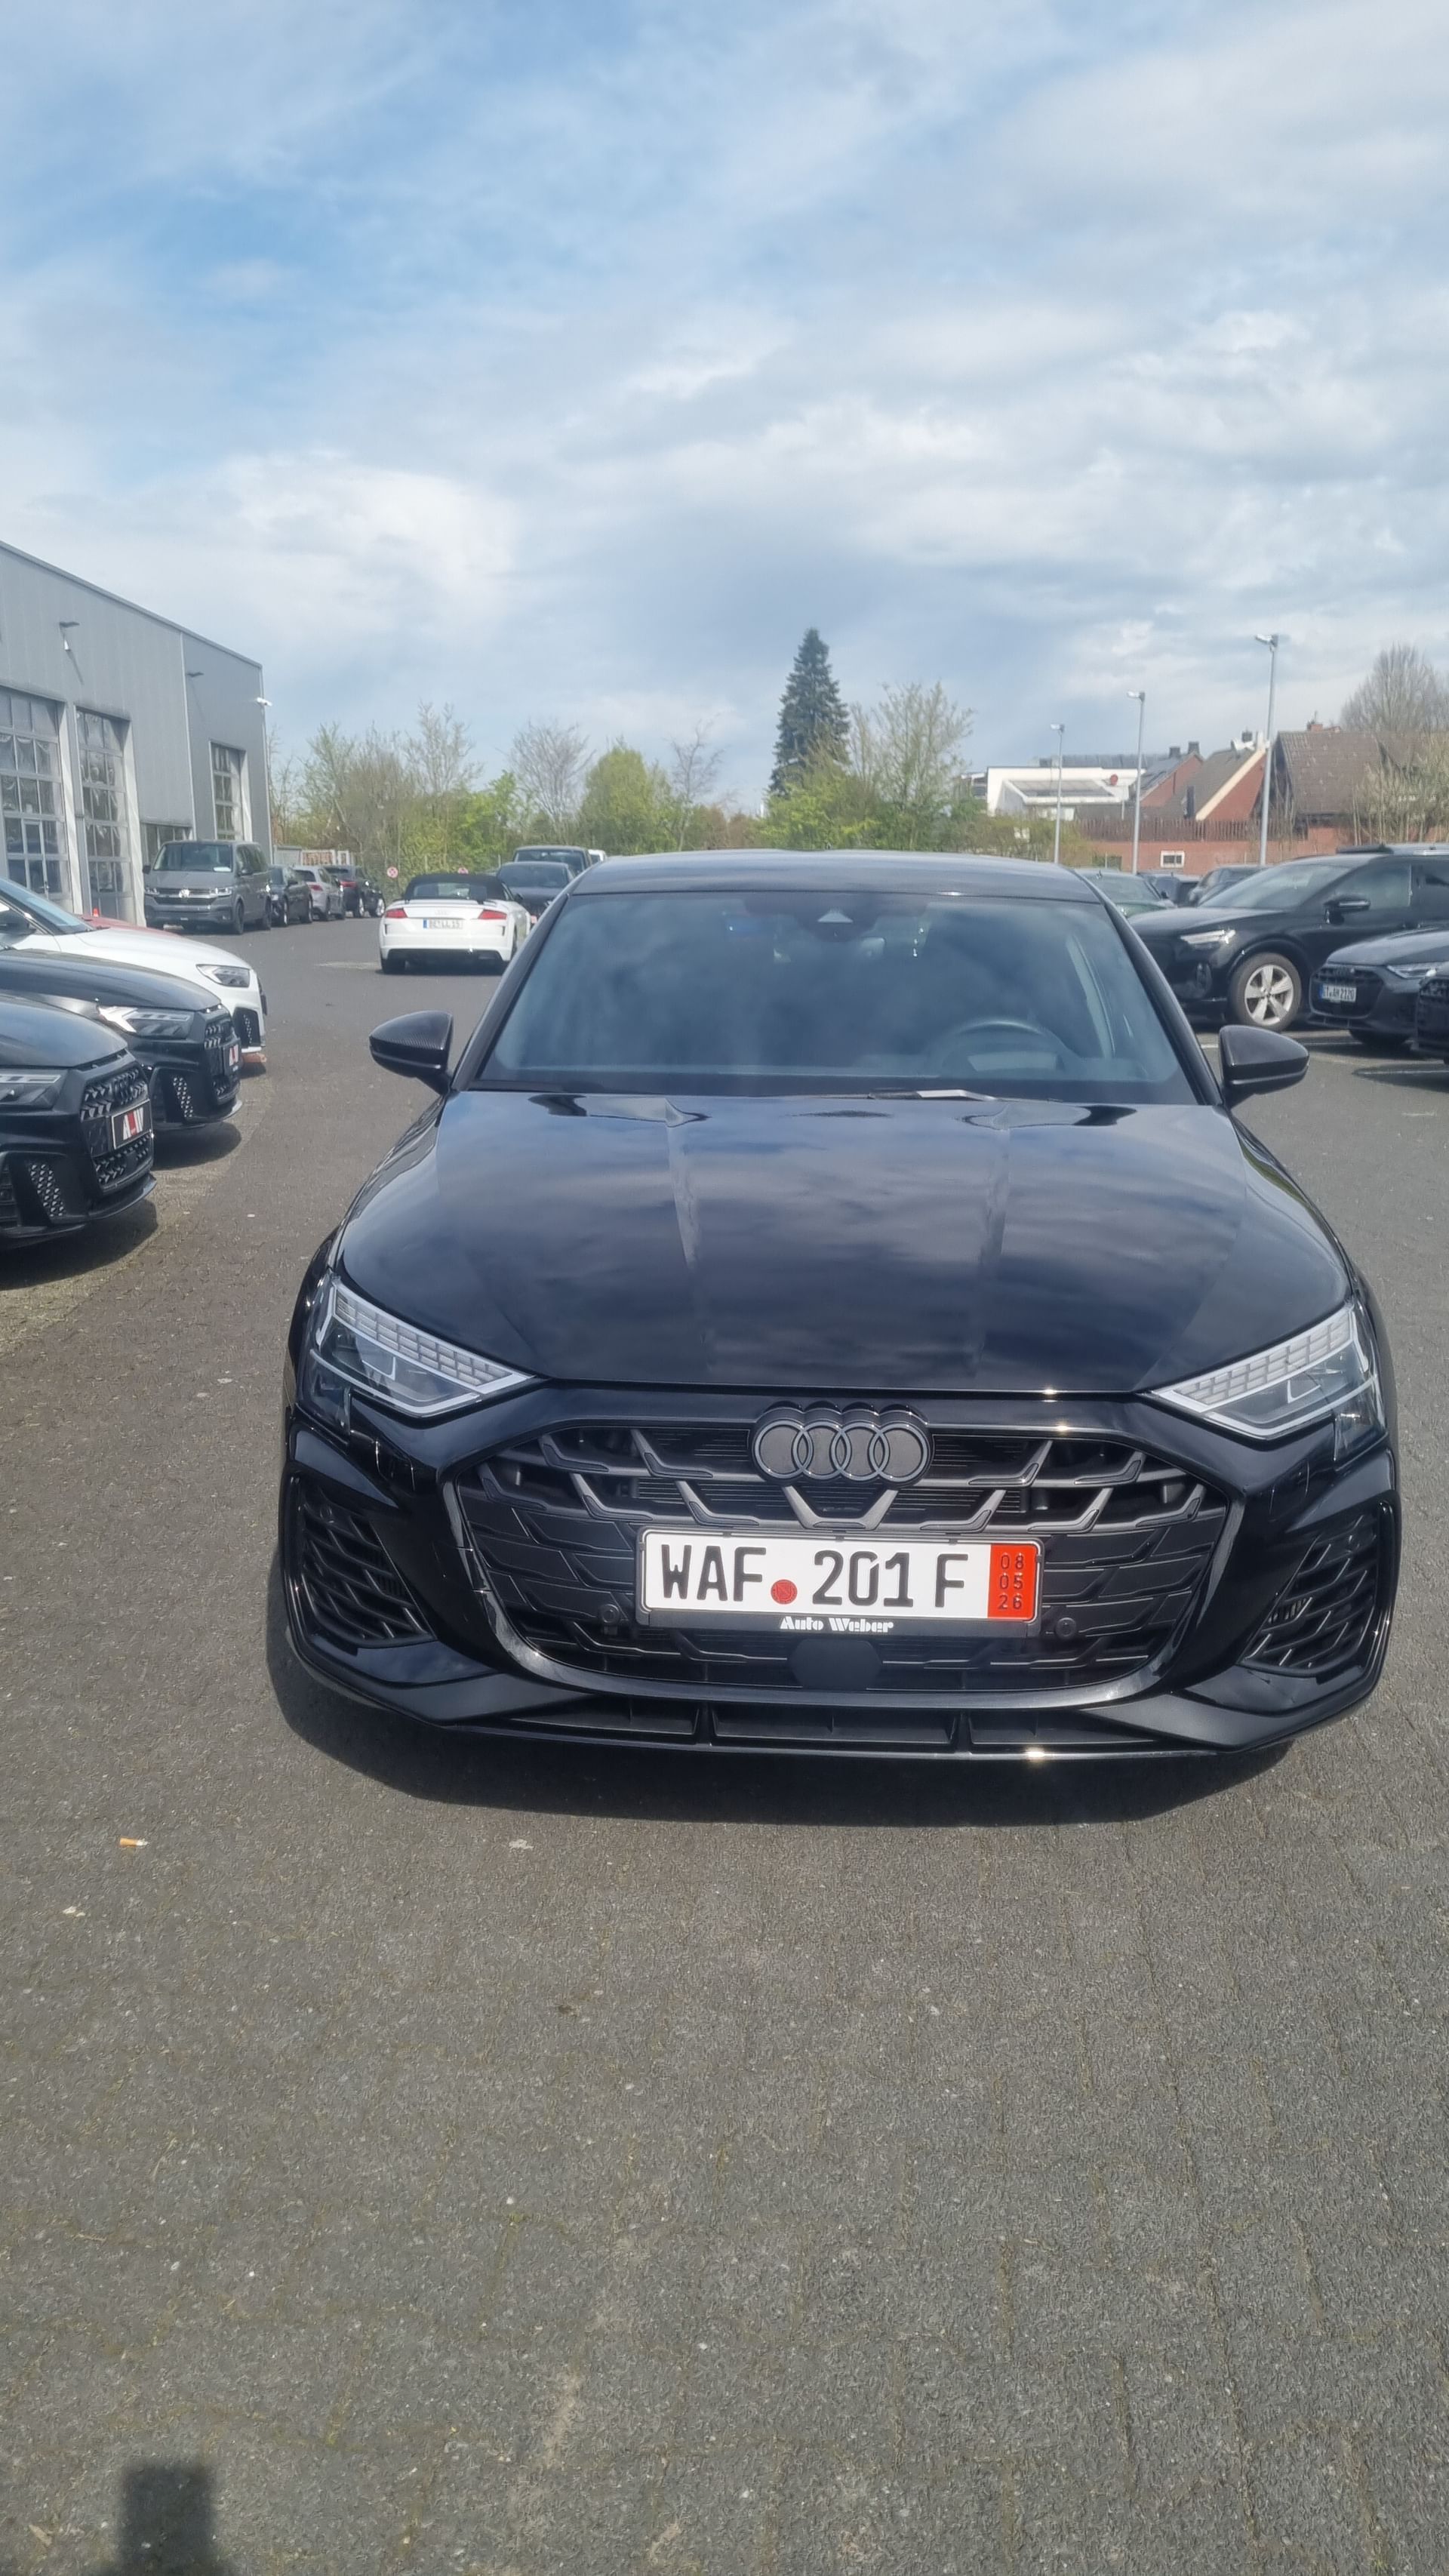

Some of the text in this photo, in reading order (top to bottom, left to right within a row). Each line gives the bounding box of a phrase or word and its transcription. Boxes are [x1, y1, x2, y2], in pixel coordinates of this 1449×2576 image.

[1000, 1552, 1024, 1570] 08
[661, 1544, 767, 1602] WAF
[812, 1550, 914, 1608] 201
[934, 1553, 969, 1608] F
[999, 1572, 1023, 1590] 05
[998, 1593, 1023, 1610] 26
[780, 1616, 894, 1633] Auto Weber
